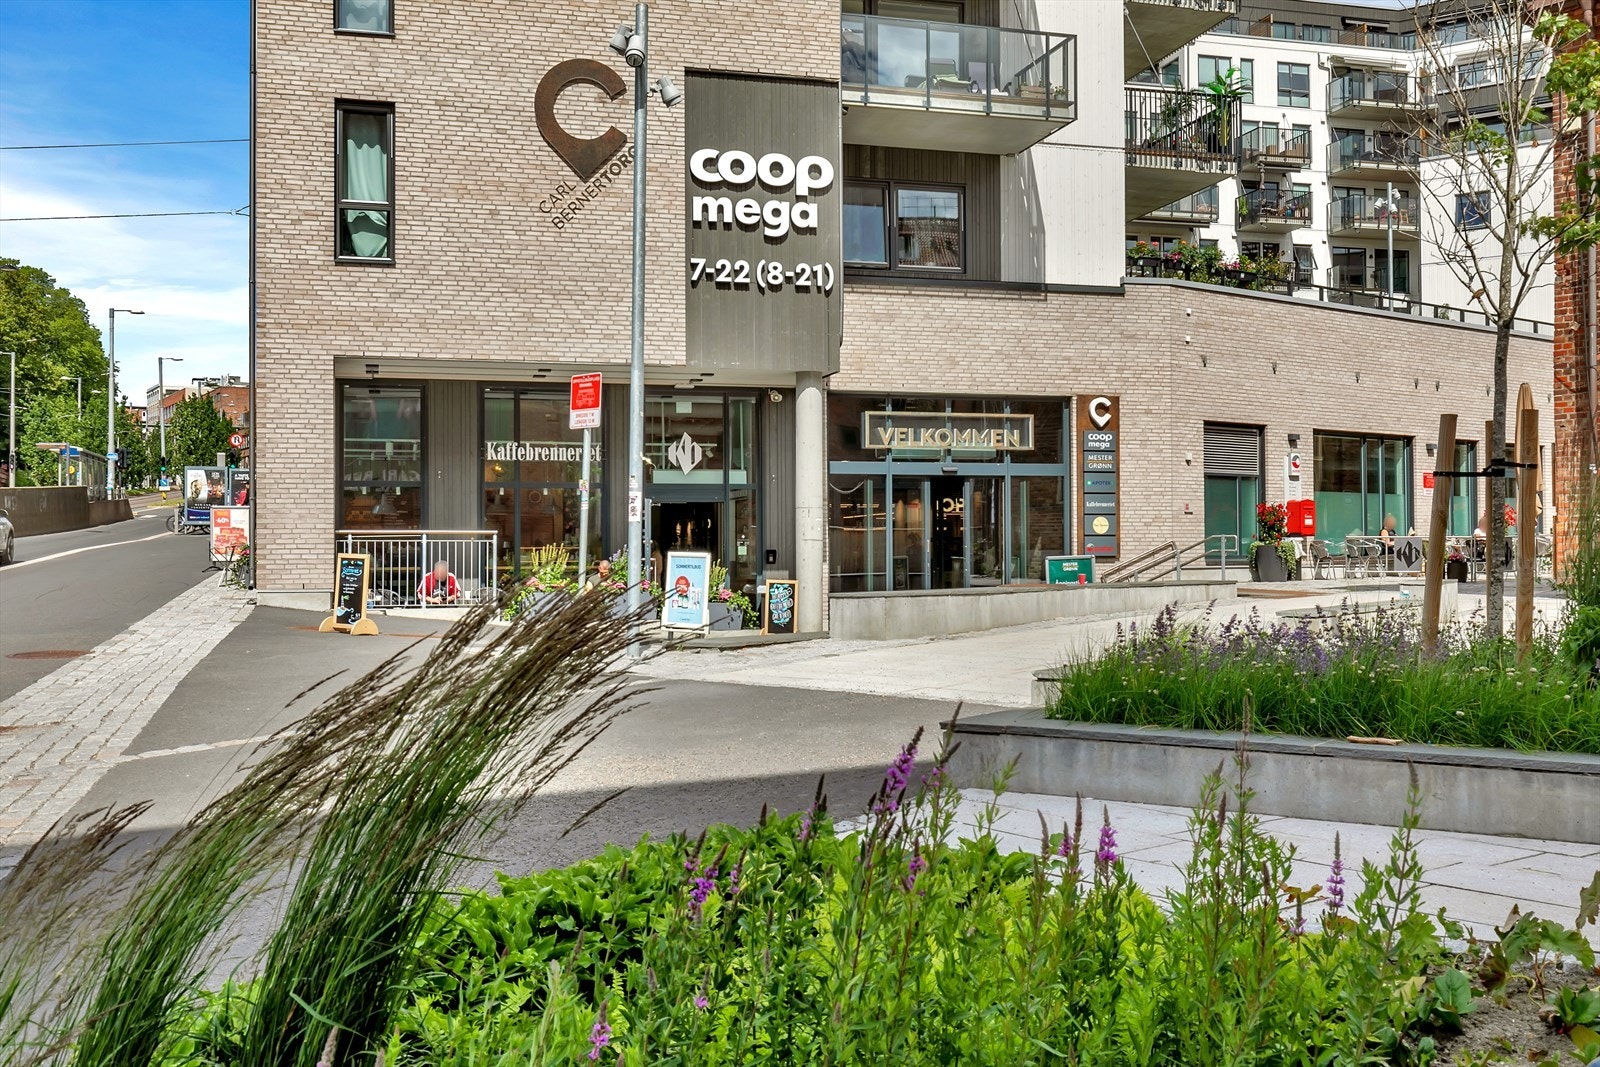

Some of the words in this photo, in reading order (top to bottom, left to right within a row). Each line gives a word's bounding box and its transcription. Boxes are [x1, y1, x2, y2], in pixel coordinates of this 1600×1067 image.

[690, 149, 834, 195] coop
[539, 181, 577, 213] CARL
[692, 195, 818, 237] mega
[690, 258, 750, 283] 7-22
[757, 259, 834, 291] (8-21)
[878, 427, 1020, 448] VELKOMMEN
[1088, 433, 1112, 442] coop
[1088, 441, 1110, 449] mega
[487, 441, 601, 462] Kaffebrenneret
